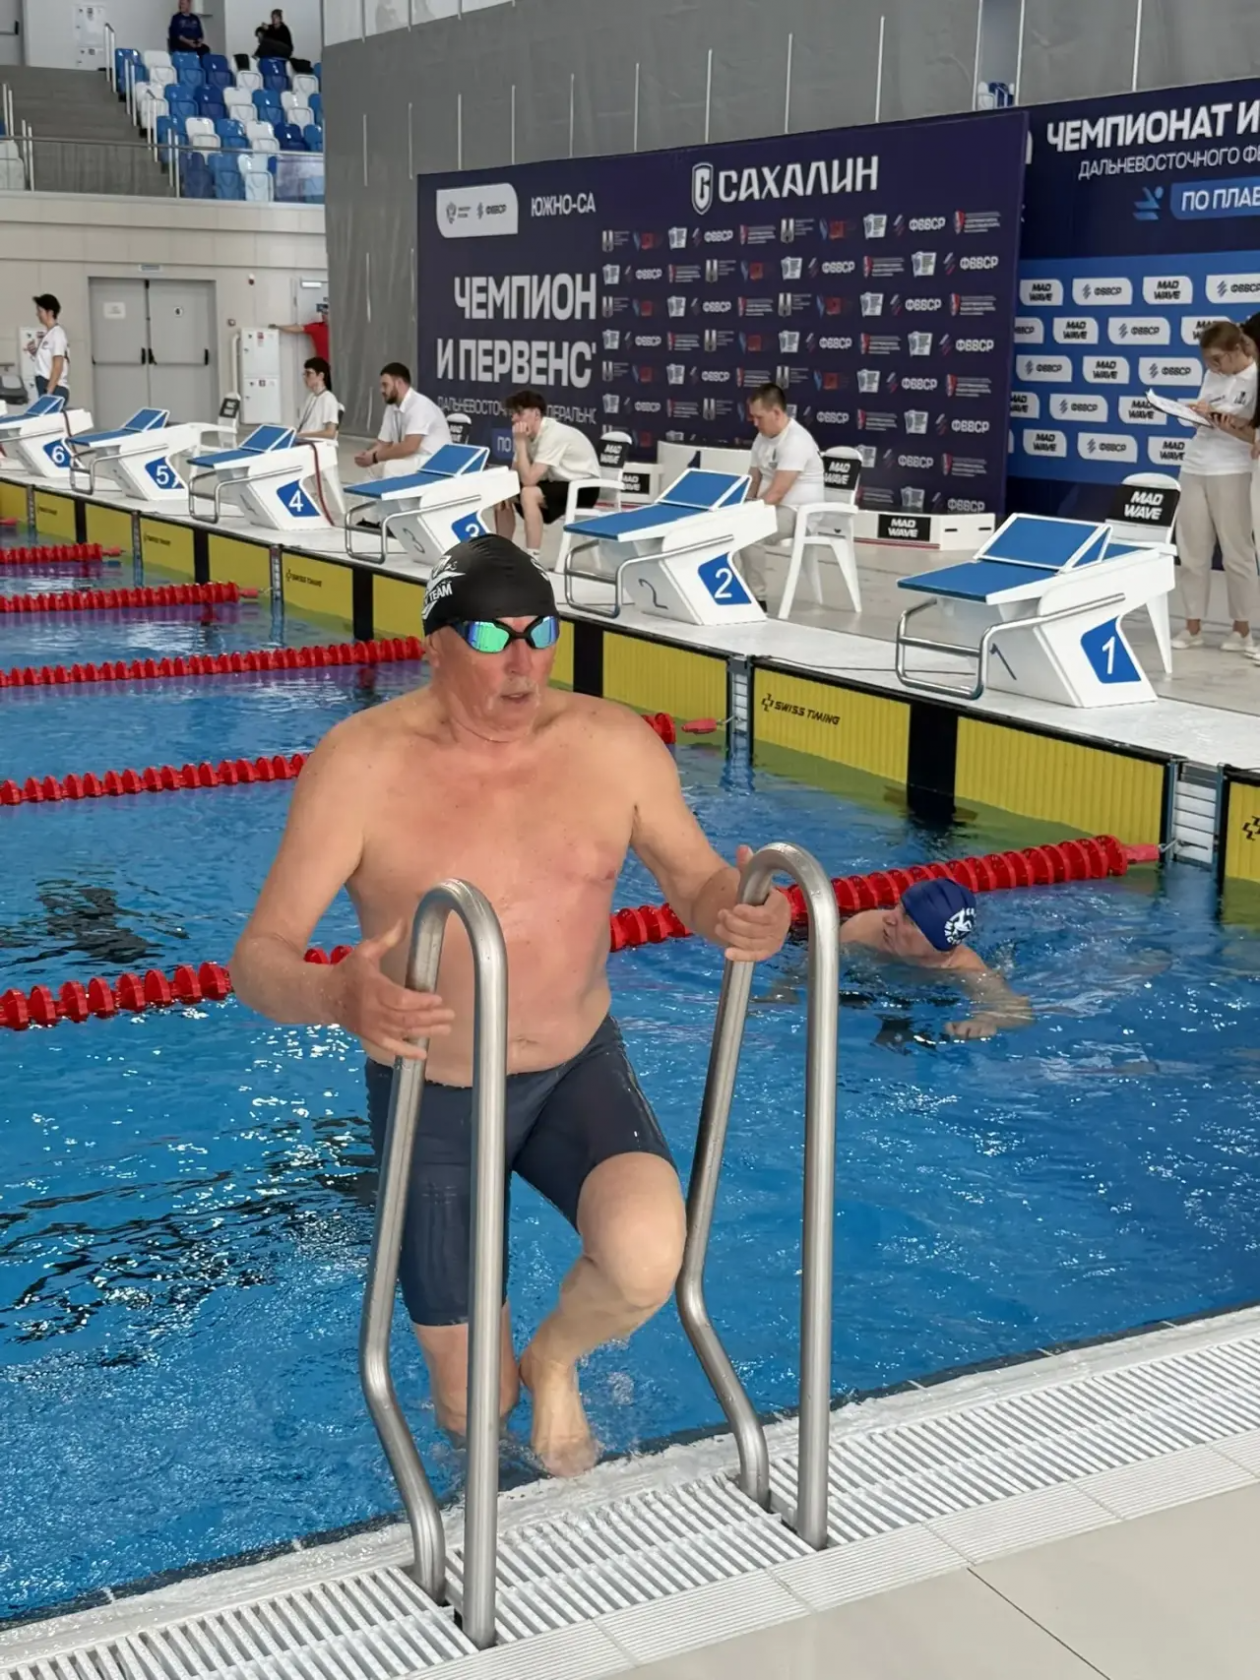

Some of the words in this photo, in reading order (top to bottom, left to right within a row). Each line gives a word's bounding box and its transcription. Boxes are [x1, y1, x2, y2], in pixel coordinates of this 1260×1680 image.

[1047, 103, 1233, 152] ЧЕМПИОНАТ
[1237, 100, 1260, 135] И
[1078, 147, 1240, 180] ДАЛЬНЕВОСТОЧНОГО
[718, 155, 878, 203] САХАЛИН
[531, 192, 596, 217] ЮЖНО-СА
[1181, 190, 1209, 212] ПО
[1032, 283, 1052, 292] MAD
[1157, 280, 1179, 290] MAD
[454, 273, 597, 320] ЧЕМПИОН
[1029, 292, 1053, 302] WAVE
[1154, 290, 1181, 300] WAVE
[1066, 321, 1087, 330] MAD
[1063, 330, 1088, 340] WAVE
[436, 338, 454, 380] И
[459, 339, 597, 388] ПЕРВЕНС
[1095, 360, 1116, 370] MAD
[1092, 370, 1118, 380] WAVE
[1131, 400, 1152, 409] MAD
[1128, 410, 1154, 419] WAVE
[1035, 433, 1056, 442] MAD
[1033, 442, 1057, 452] WAVE
[1162, 441, 1185, 450] MAD
[52, 445, 66, 464] 6
[828, 461, 851, 473] MAD
[156, 466, 169, 485] 5
[824, 472, 850, 485] WAVE
[288, 489, 304, 512] 4
[1130, 490, 1164, 506] MAD
[1124, 504, 1163, 520] WAVE
[891, 518, 916, 528] MAD
[888, 527, 918, 538] WAVE
[714, 568, 733, 598] 2
[429, 583, 453, 601] TEAM
[1102, 636, 1115, 675] 1
[774, 701, 806, 716] SWISS
[806, 709, 841, 725] TIMING
